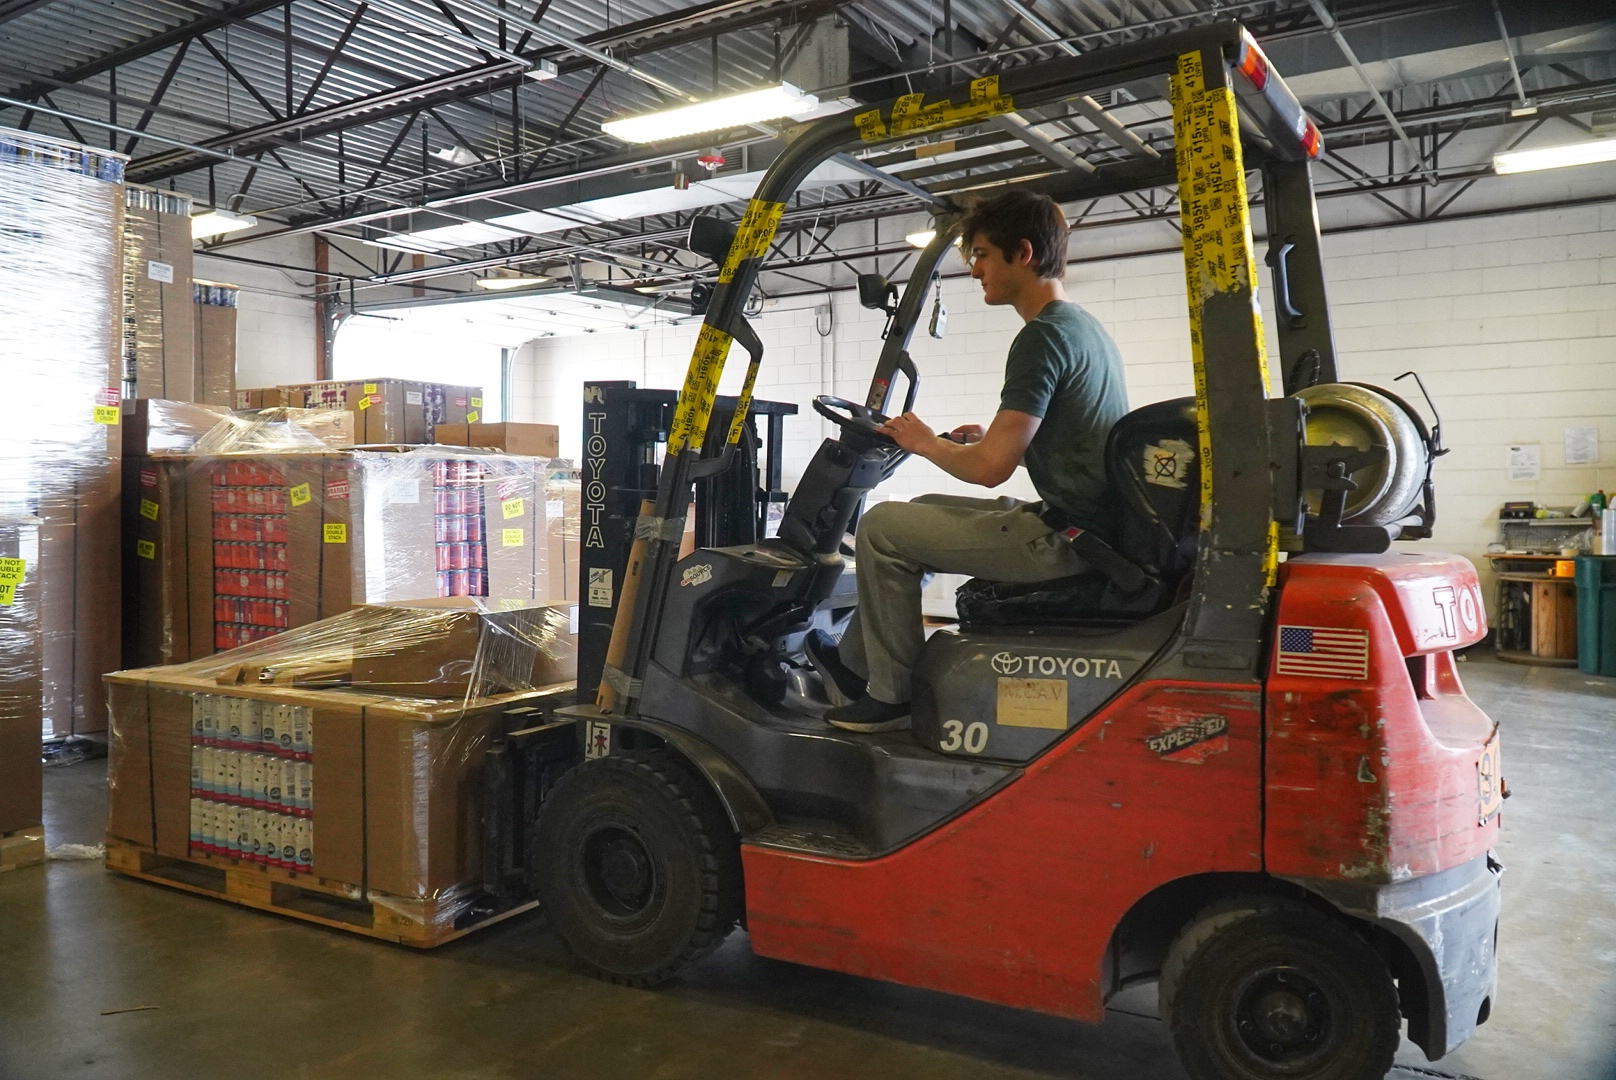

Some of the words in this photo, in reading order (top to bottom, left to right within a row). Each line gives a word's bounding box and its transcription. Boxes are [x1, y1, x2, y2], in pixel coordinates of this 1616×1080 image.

[1183, 57, 1195, 88] 415H
[1209, 161, 1224, 194] 375H
[1191, 199, 1205, 232] 385H
[699, 354, 711, 379] 408H
[683, 406, 696, 432] 408H
[586, 412, 606, 548] TOYOTA
[1024, 655, 1123, 679] TOYOTA
[939, 719, 989, 754] 30
